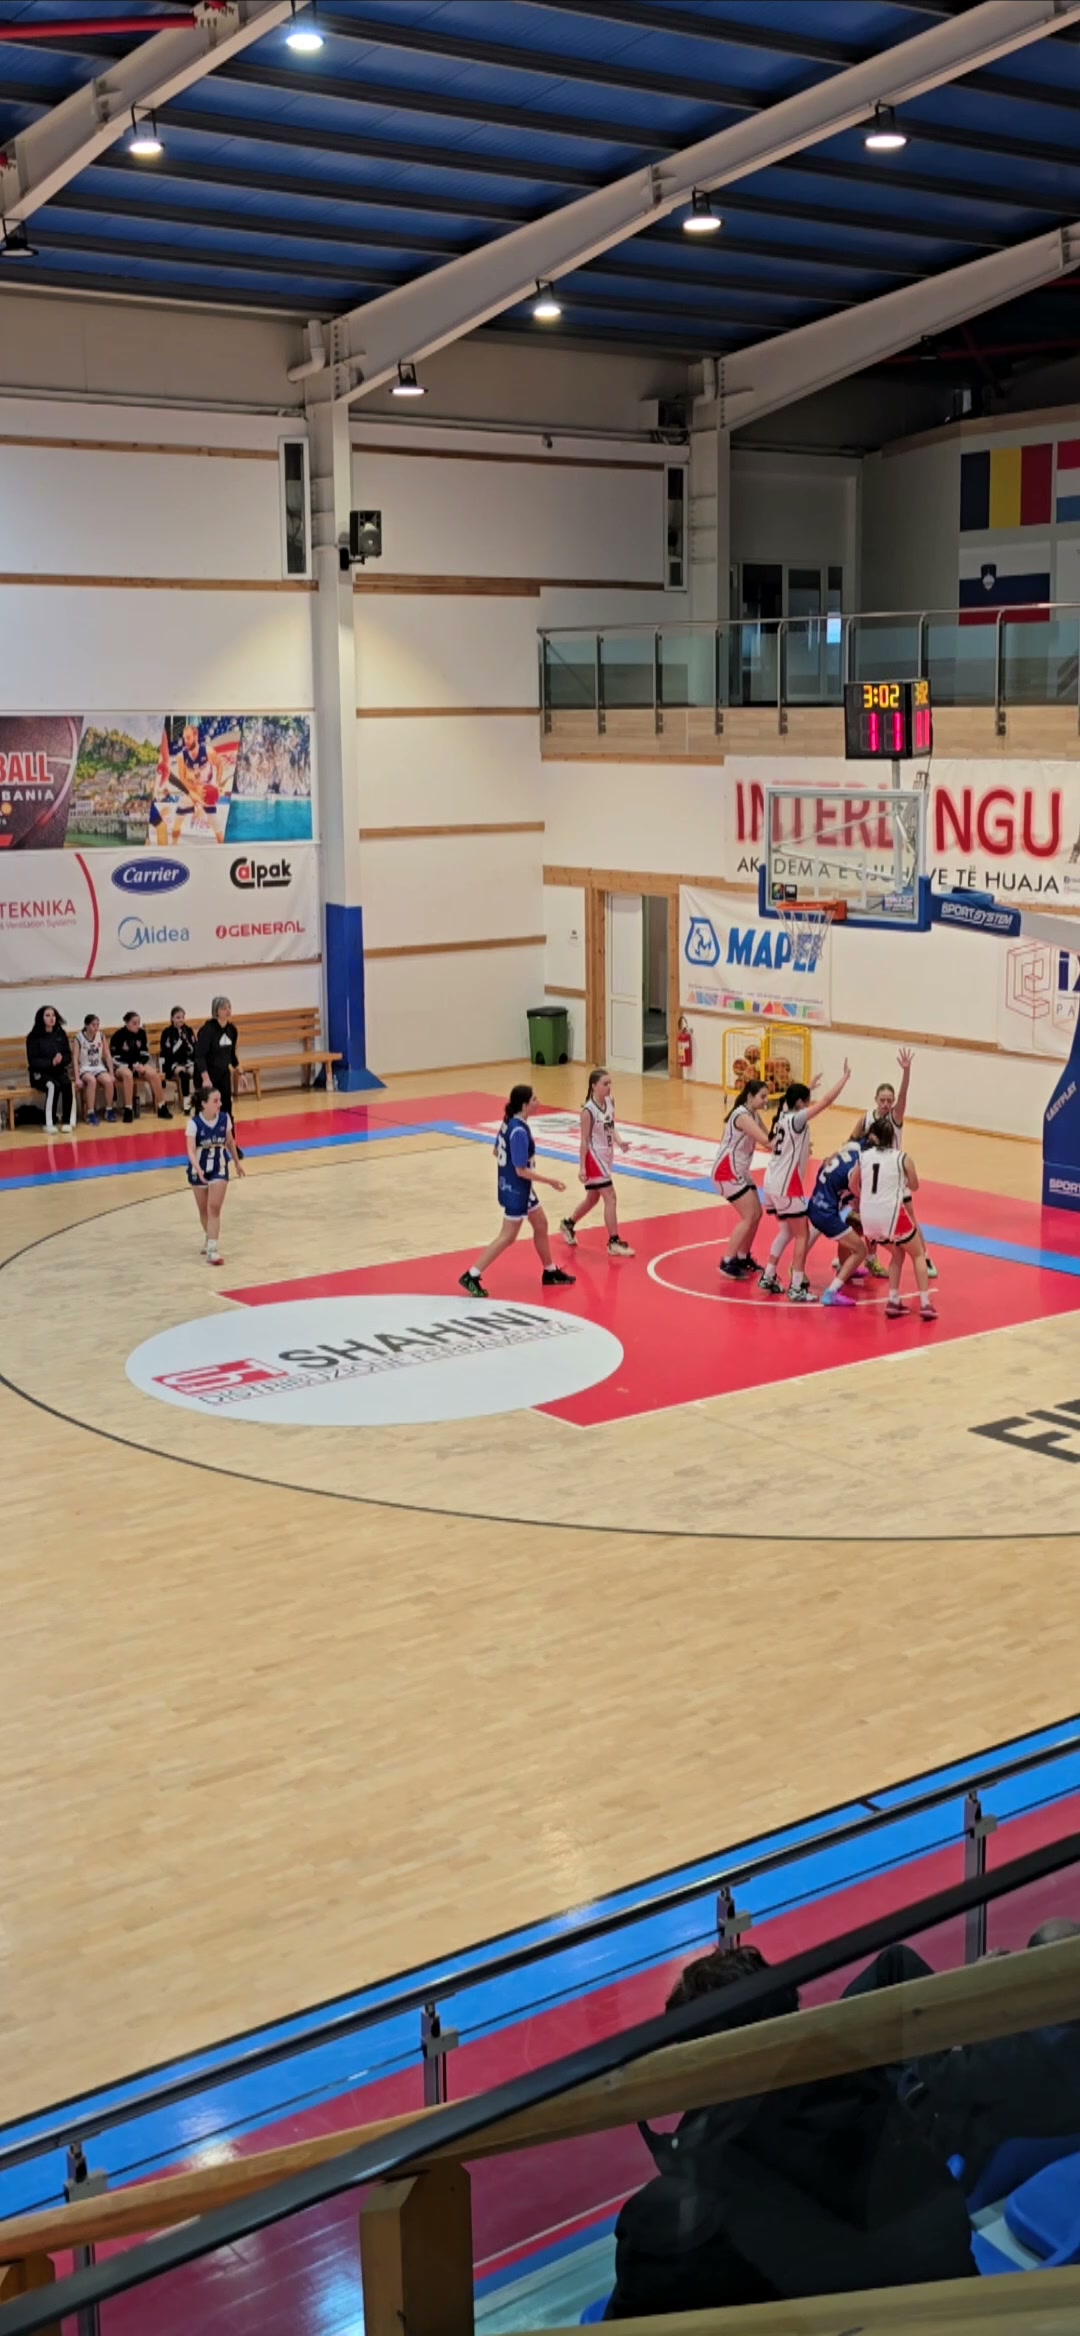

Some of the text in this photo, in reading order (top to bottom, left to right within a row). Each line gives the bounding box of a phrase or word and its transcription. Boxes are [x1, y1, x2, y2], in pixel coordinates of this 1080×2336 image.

[864, 685, 899, 709] 3:02
[869, 712, 903, 752] 11
[123, 866, 180, 884] Carrier
[230, 857, 292, 889] Calpak
[985, 871, 1060, 894] HUAJA
[0, 899, 76, 919] TEKNIKA
[126, 920, 190, 948] Midea
[229, 921, 306, 938] GENERAL
[726, 927, 822, 973] MAPEI
[871, 1162, 880, 1194] 1
[278, 1307, 552, 1369] SHAHINI
